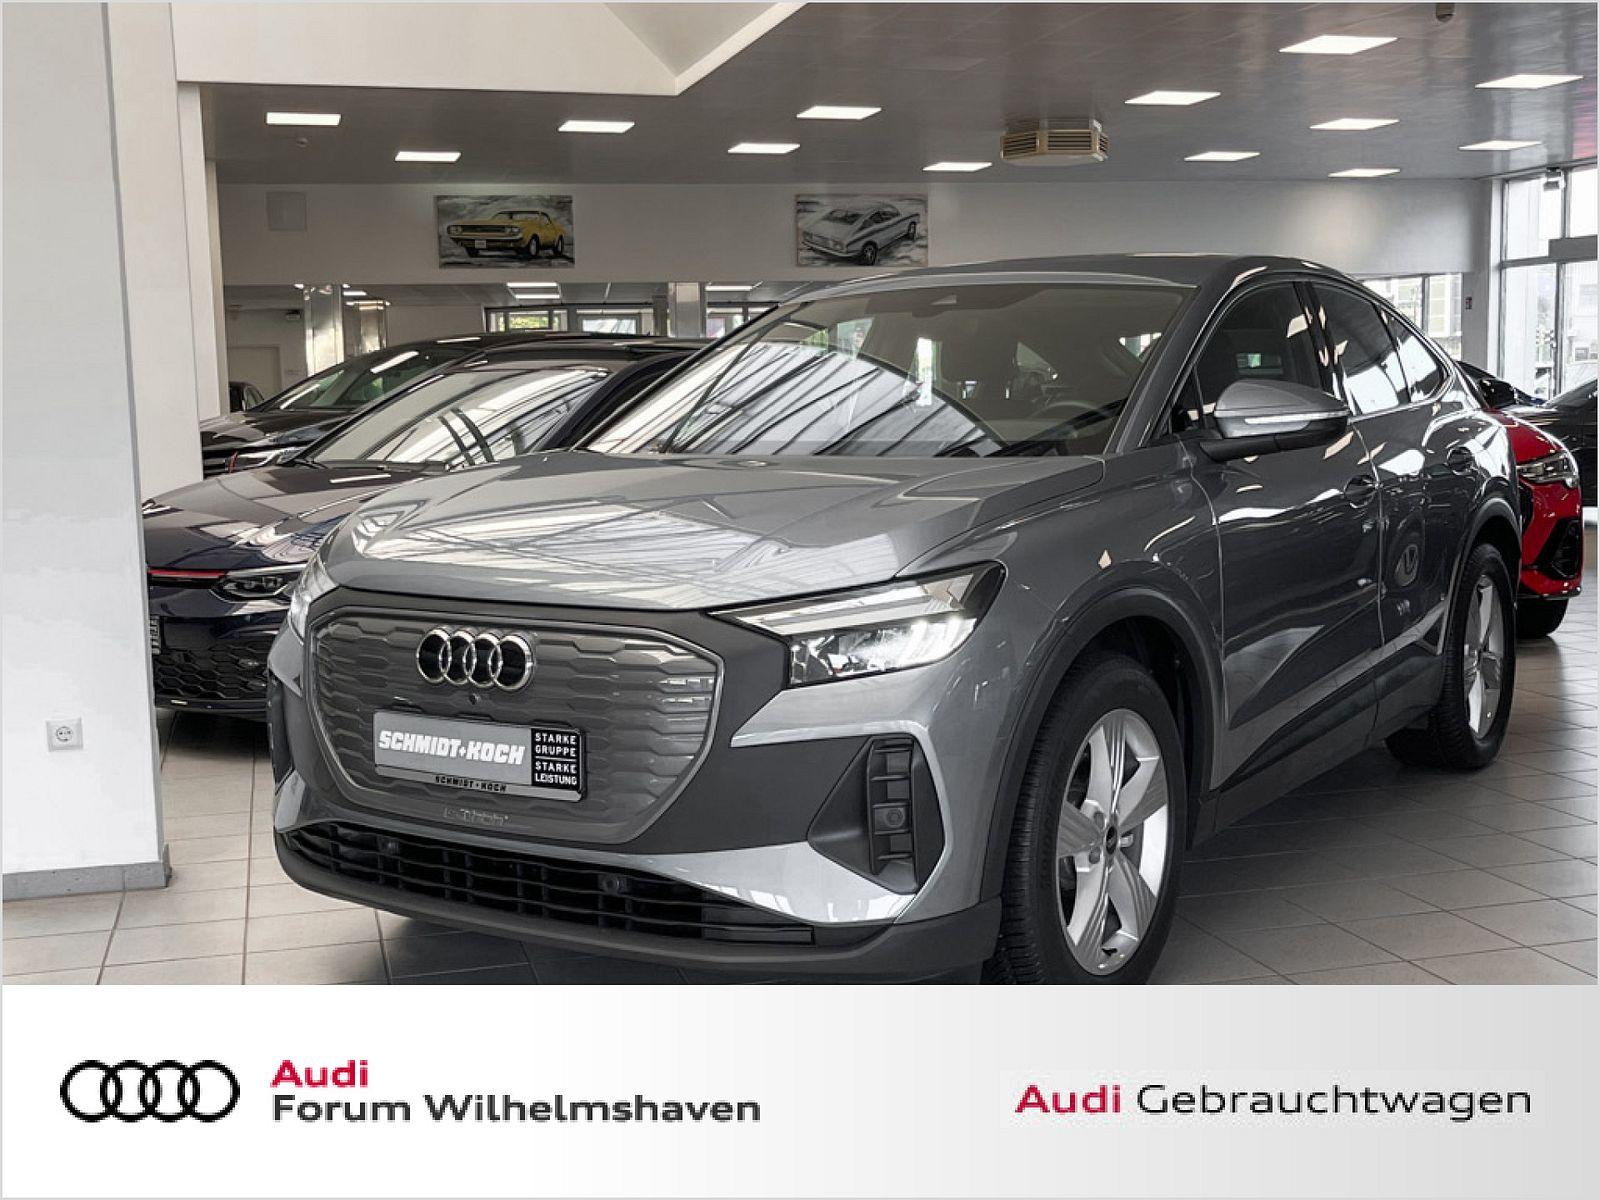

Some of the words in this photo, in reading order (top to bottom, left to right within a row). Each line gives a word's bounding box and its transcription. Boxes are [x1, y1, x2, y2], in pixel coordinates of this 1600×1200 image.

[535, 732, 577, 745] STARKE
[535, 744, 577, 757] GRUPPE
[535, 760, 577, 774] STARKE
[535, 772, 577, 785] LEISTUNG
